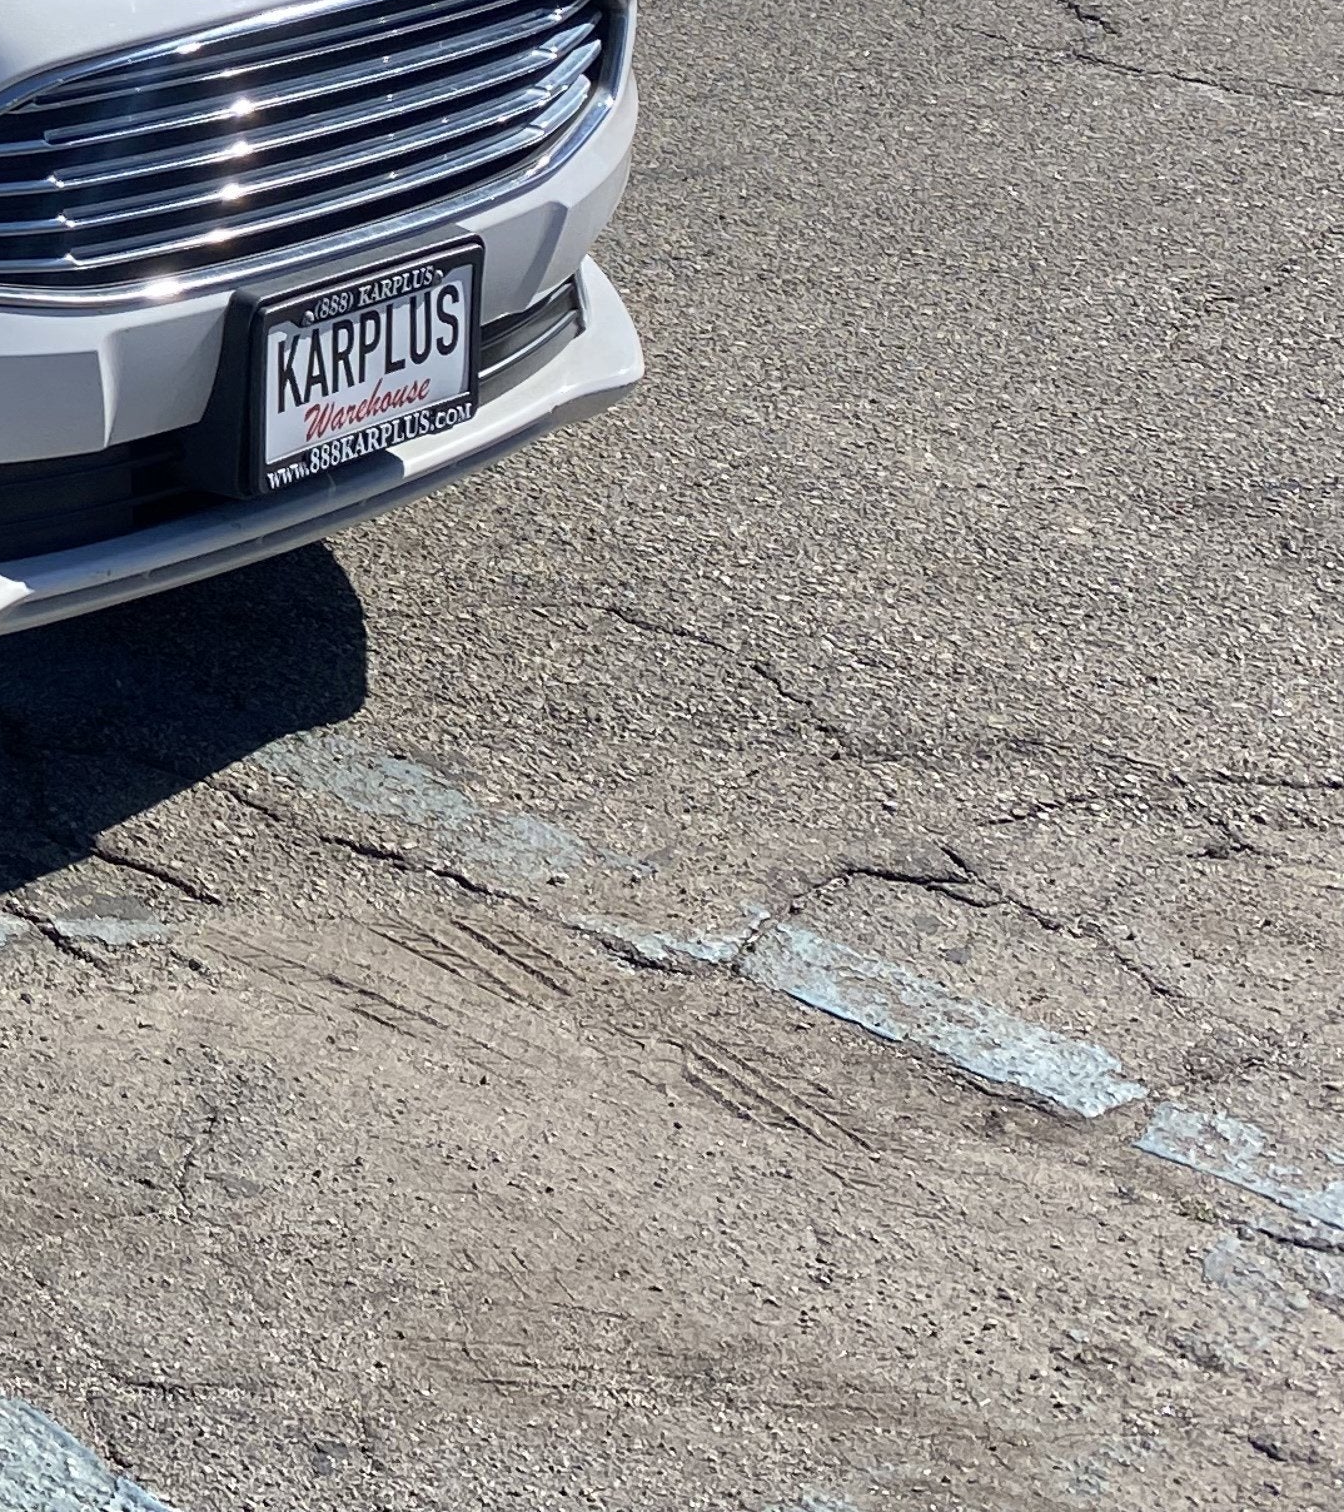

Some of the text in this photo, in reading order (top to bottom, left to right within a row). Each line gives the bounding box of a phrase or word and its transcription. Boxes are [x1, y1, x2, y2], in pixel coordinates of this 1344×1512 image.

[313, 265, 434, 319] (888) KARPLUS
[277, 284, 460, 414] KARPLUS
[304, 377, 431, 442] Warehouse
